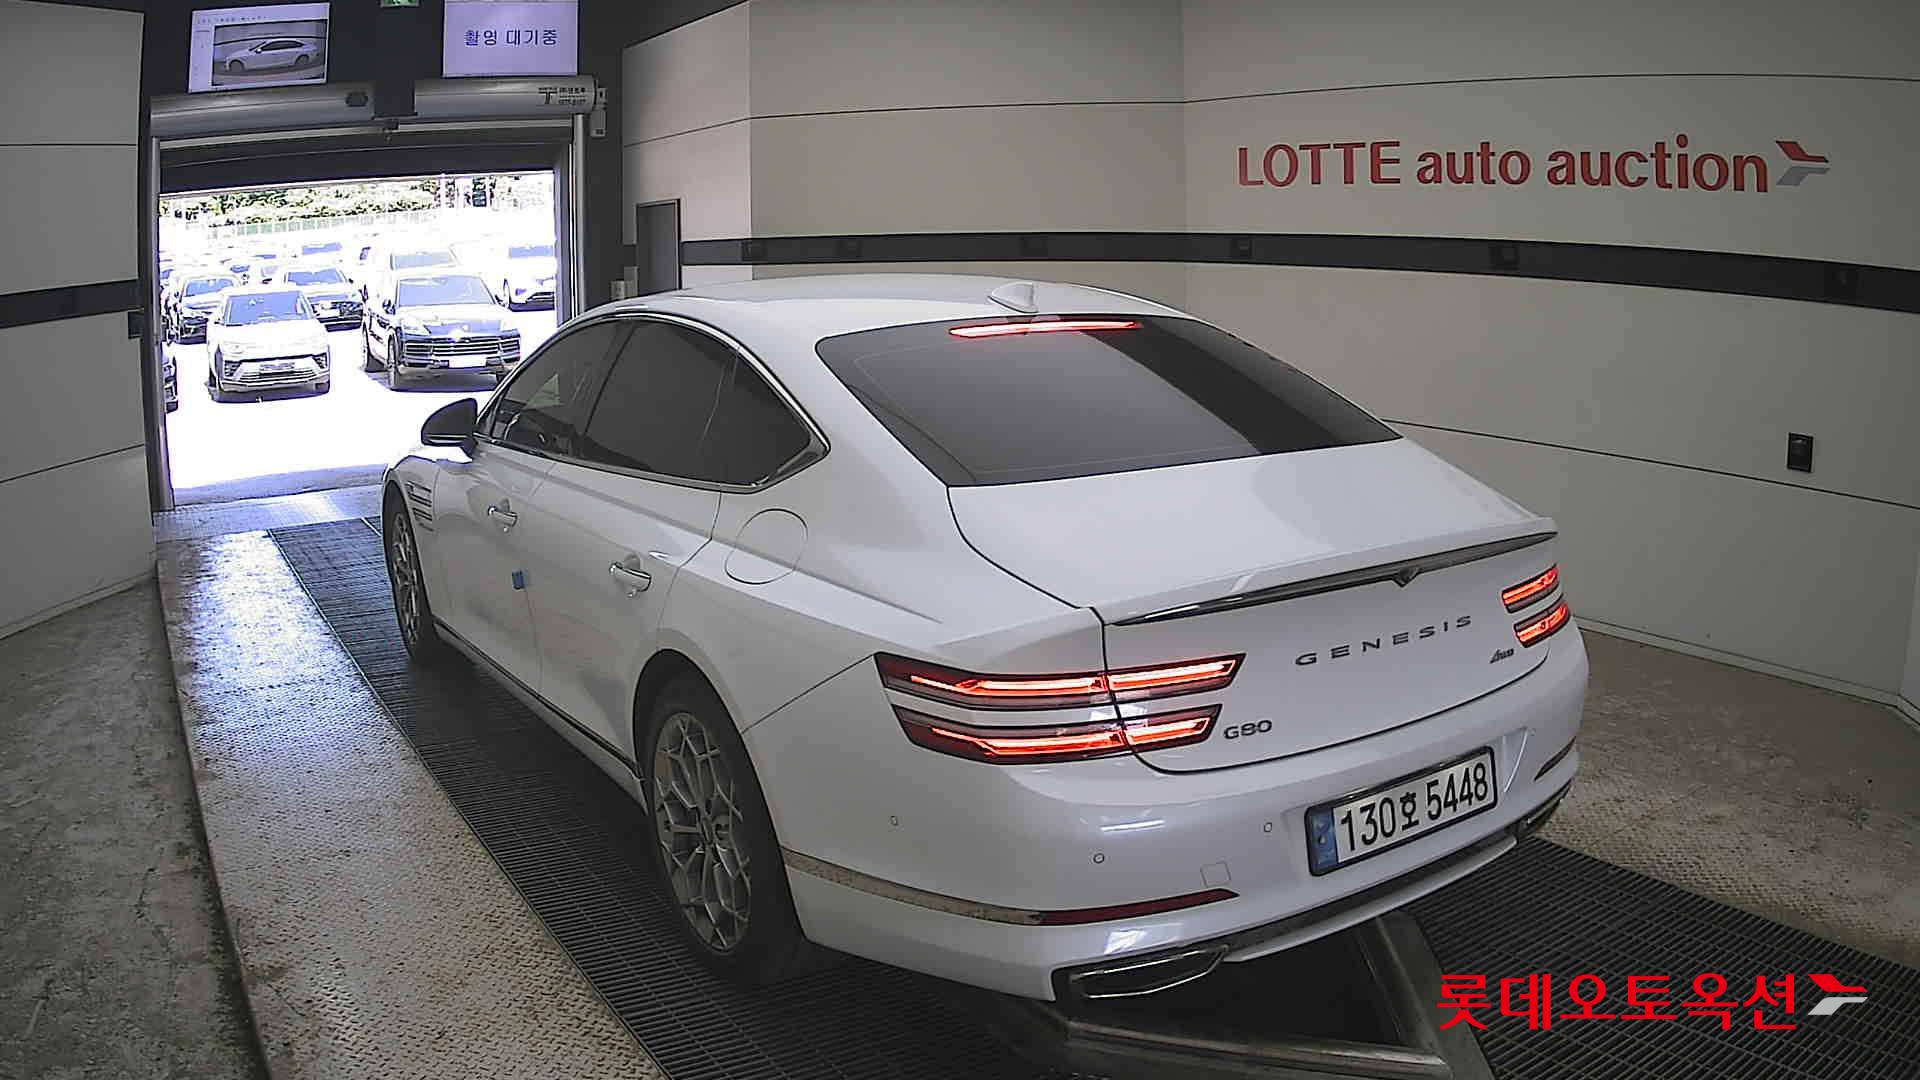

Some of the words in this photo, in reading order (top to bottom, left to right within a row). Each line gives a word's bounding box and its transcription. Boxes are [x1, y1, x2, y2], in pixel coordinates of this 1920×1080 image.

[506, 28, 558, 46] 대기중
[1238, 140, 1401, 188] LOTTE
[1416, 141, 1532, 186] auto
[1547, 133, 1769, 193] auction
[1294, 614, 1472, 667] GENESIS
[1223, 719, 1273, 740] G80
[1340, 791, 1420, 851] 130호
[1426, 762, 1489, 821] 5448
